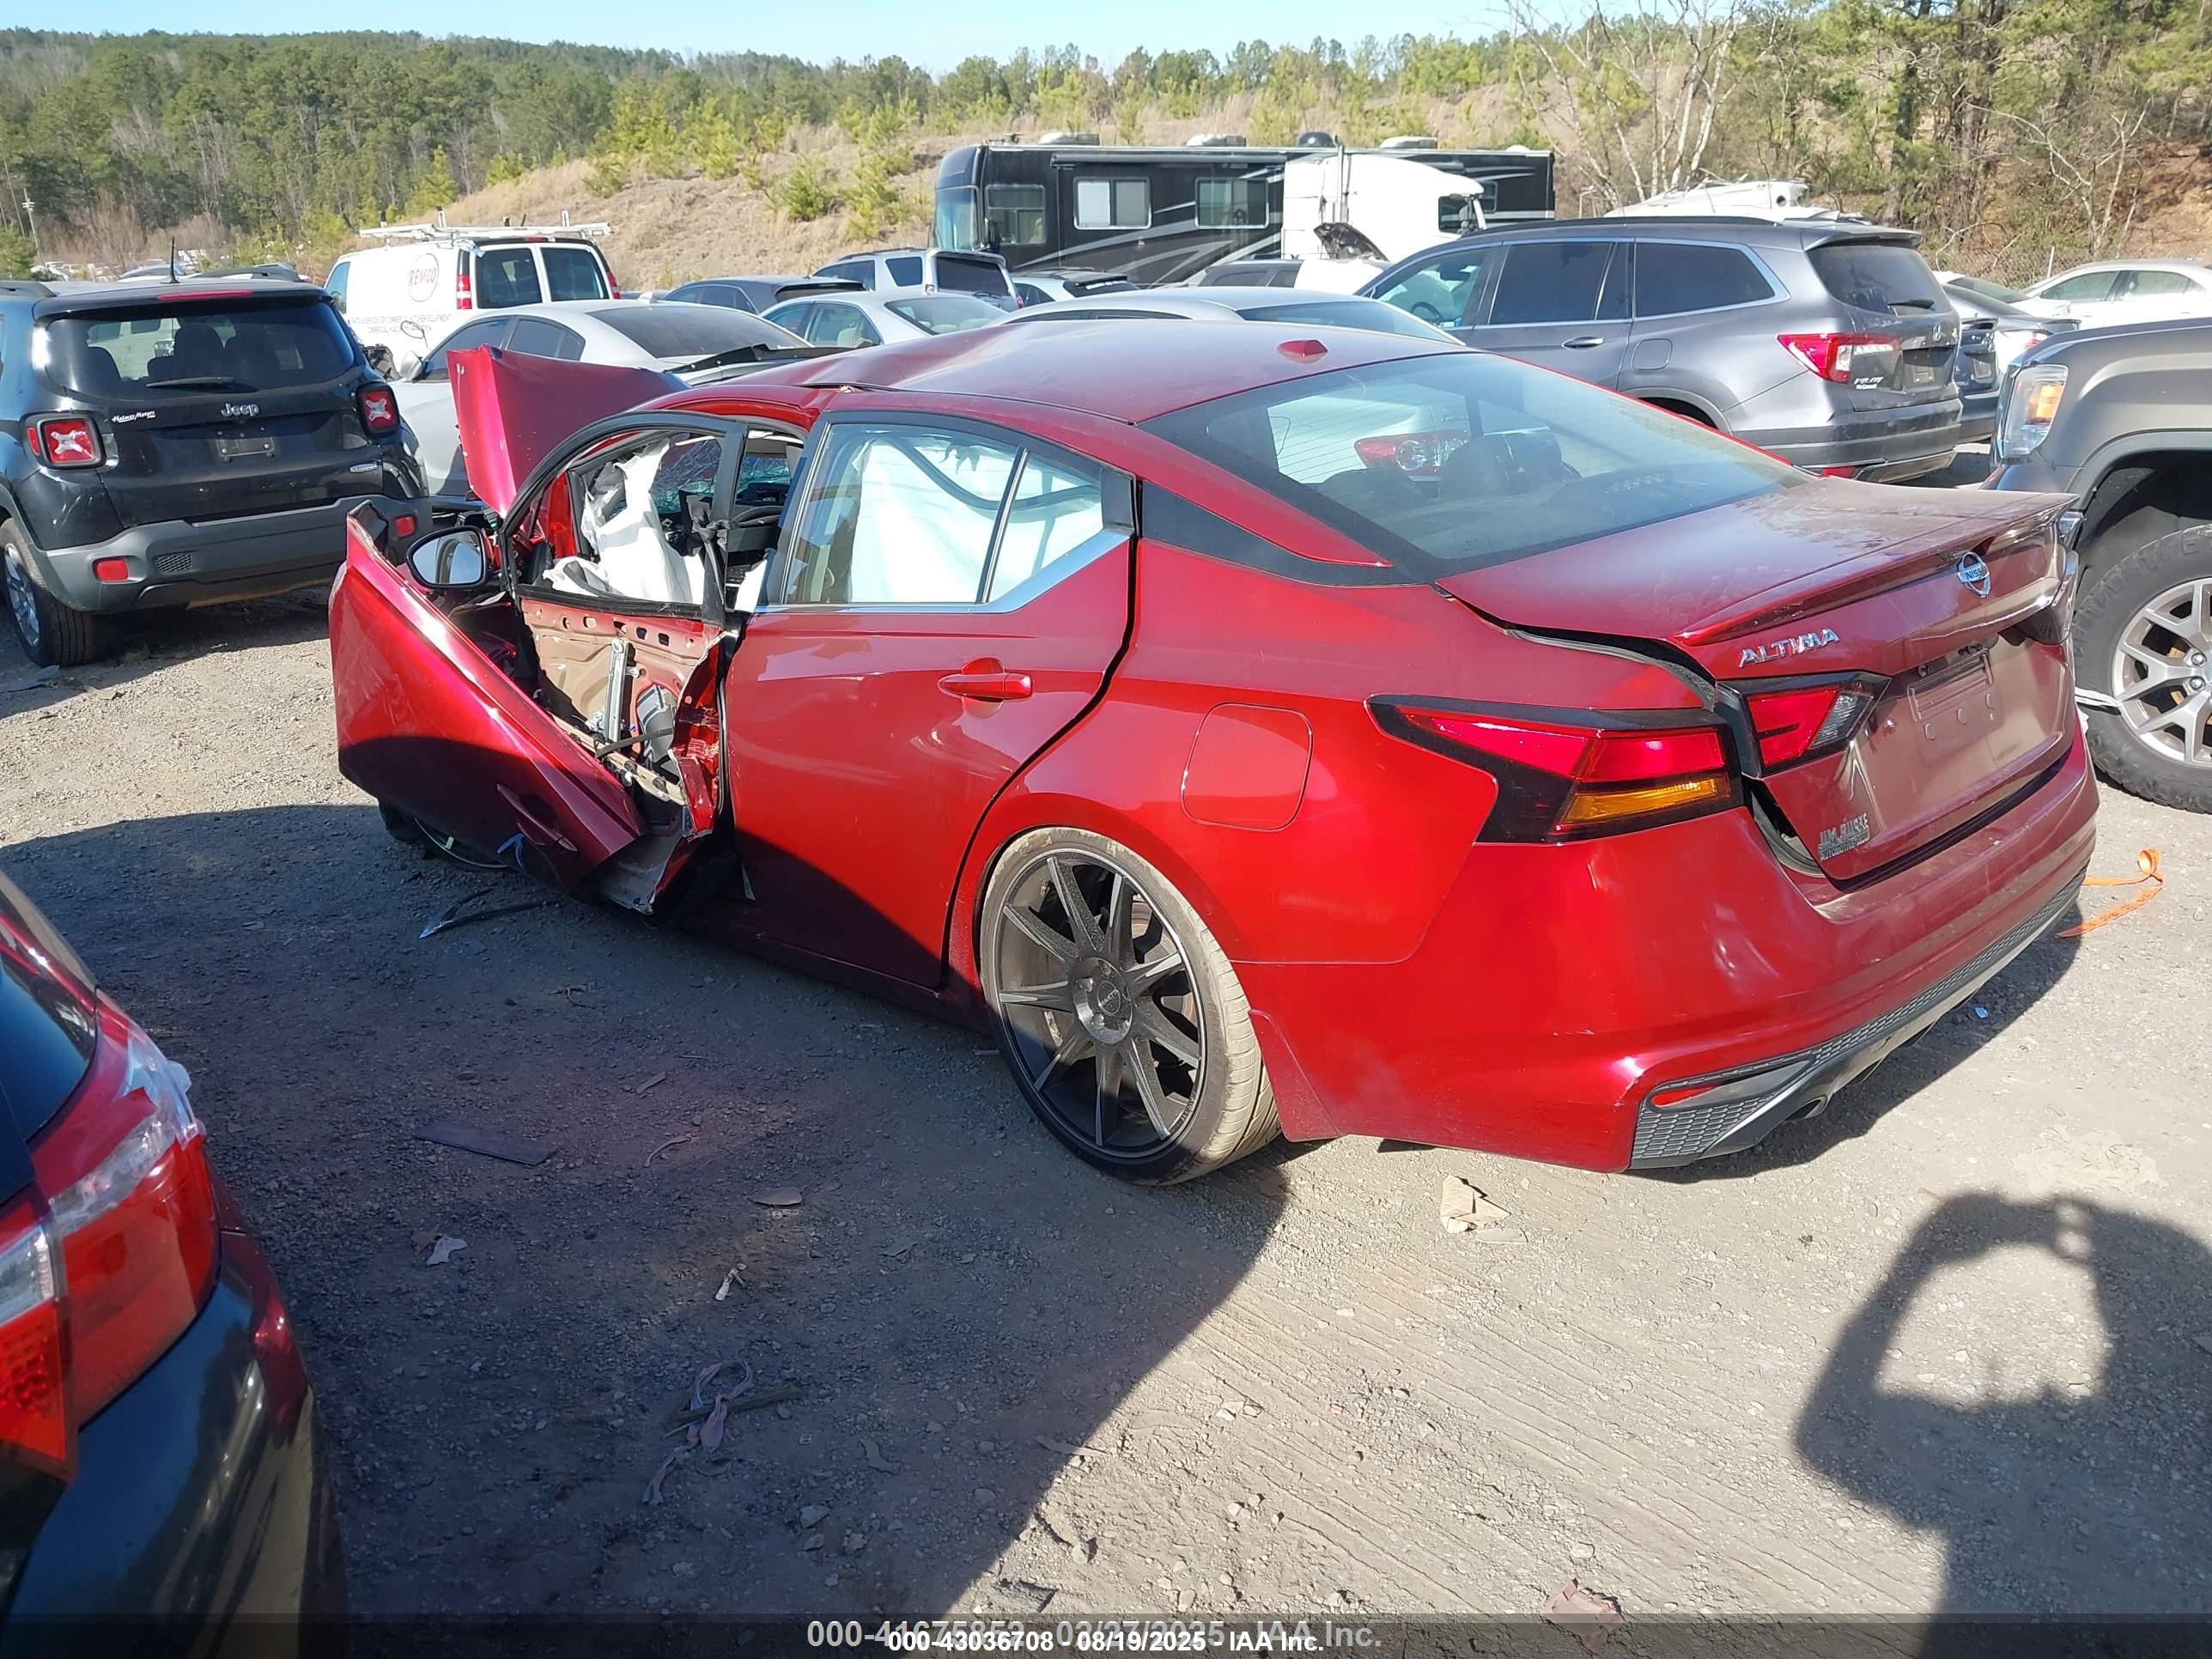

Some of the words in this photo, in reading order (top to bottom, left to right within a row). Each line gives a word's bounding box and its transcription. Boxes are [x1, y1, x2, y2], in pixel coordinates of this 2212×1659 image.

[408, 267, 437, 287] REMCO
[221, 403, 259, 416] Jeep
[1965, 567, 1984, 580] NISS
[1738, 628, 1840, 668] ALTIMA
